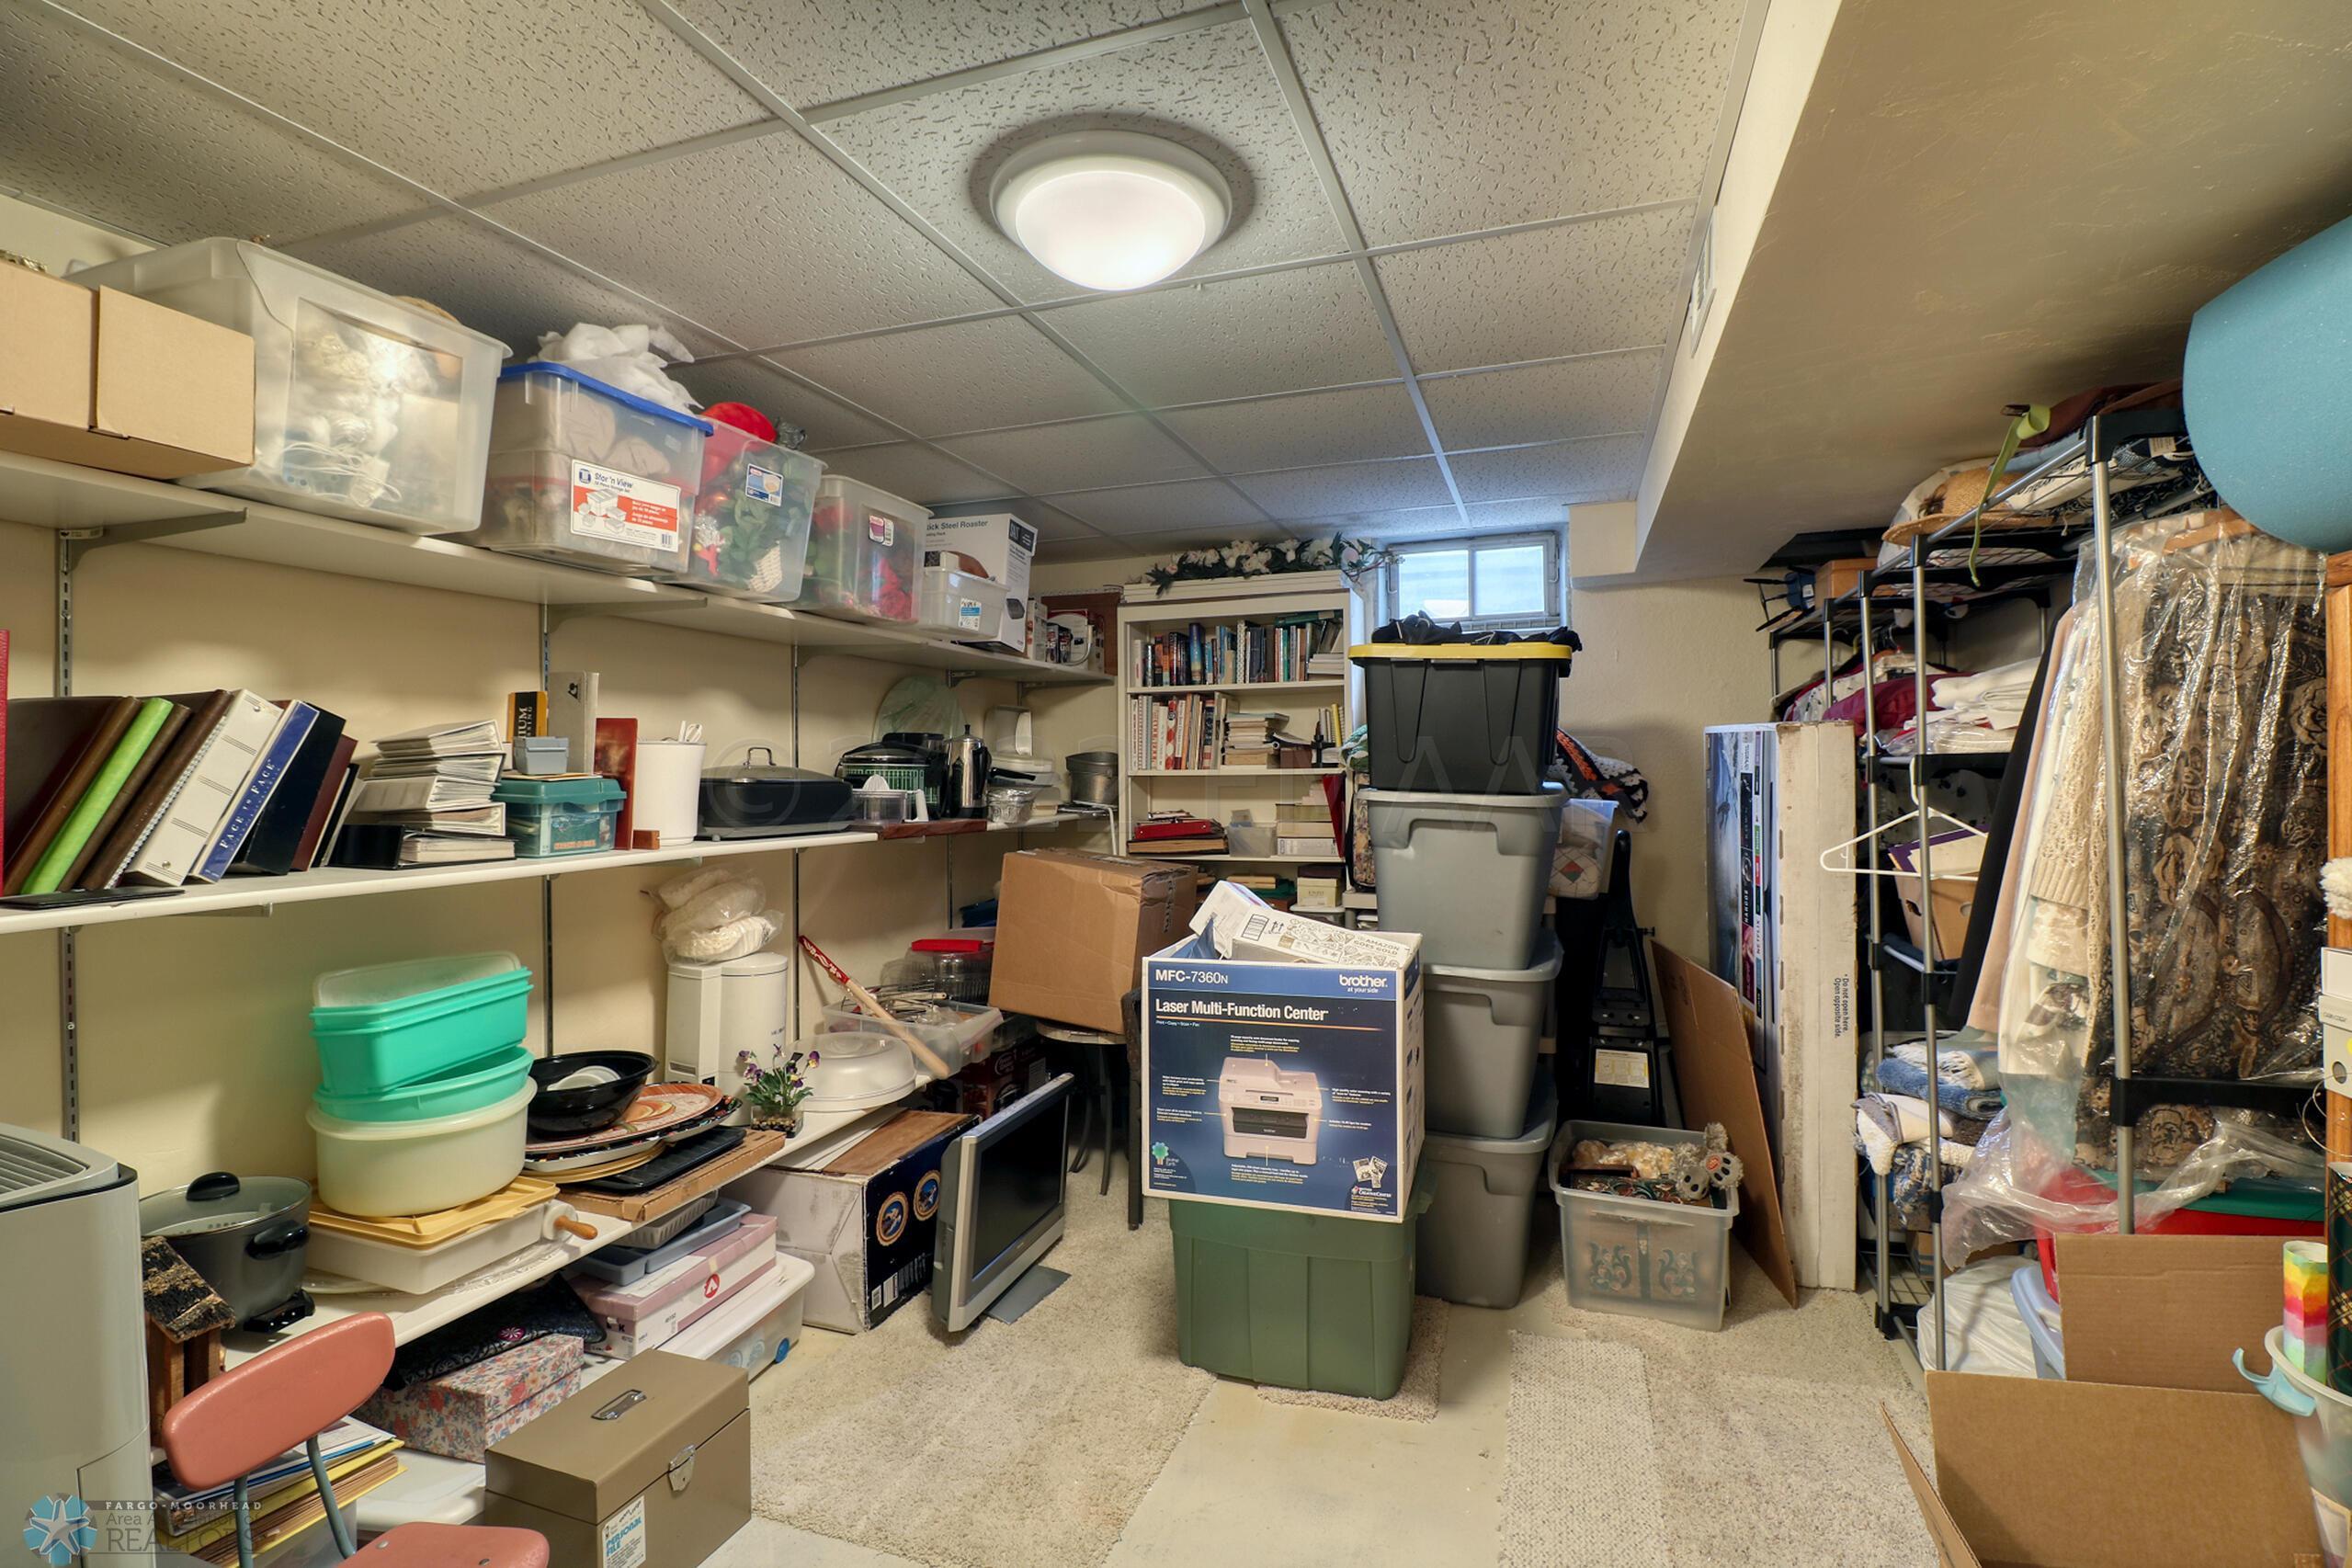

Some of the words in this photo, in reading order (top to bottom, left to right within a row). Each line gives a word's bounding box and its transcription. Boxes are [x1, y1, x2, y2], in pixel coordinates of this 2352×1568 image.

[617, 477, 633, 488] View
[941, 521, 959, 530] Steel
[960, 519, 989, 528] Roaster
[219, 816, 245, 850] FACE
[250, 762, 276, 795] FACE
[1366, 938, 1400, 951] AMAZON
[1378, 947, 1398, 956] GOLD
[1155, 969, 1229, 984] MFC-7360N
[1834, 977, 1842, 994] Open
[1155, 998, 1189, 1014] Laser
[1191, 1000, 1281, 1019] Multi-Function
[1833, 995, 1842, 1022] opposite
[1841, 1000, 1849, 1017] open
